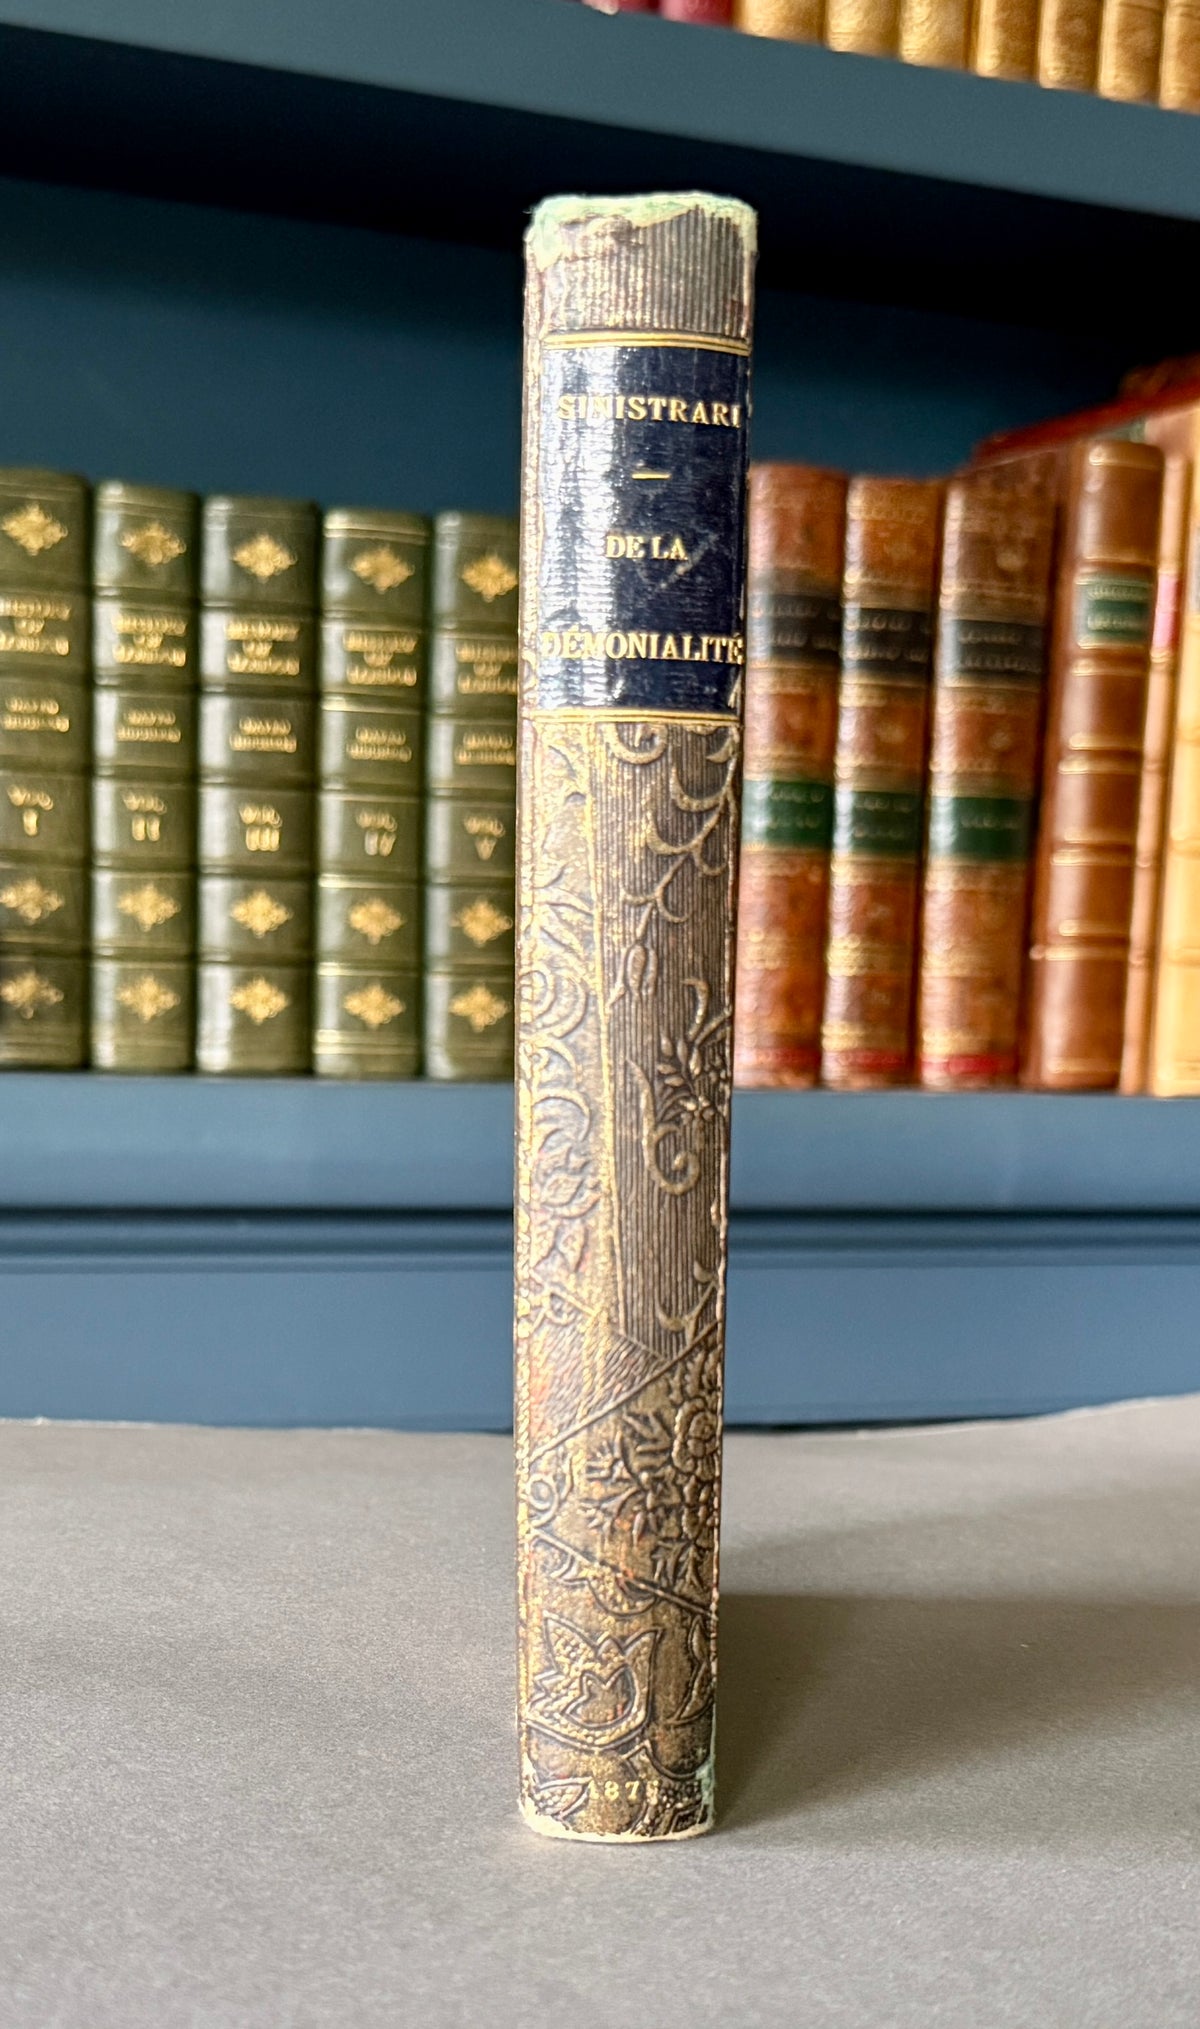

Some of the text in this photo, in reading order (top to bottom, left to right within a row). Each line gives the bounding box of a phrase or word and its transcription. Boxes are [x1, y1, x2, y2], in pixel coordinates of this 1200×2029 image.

[556, 394, 741, 428] SINISTRARI
[605, 534, 688, 560] DE LA
[541, 624, 744, 665] DÉMONIALITÉ
